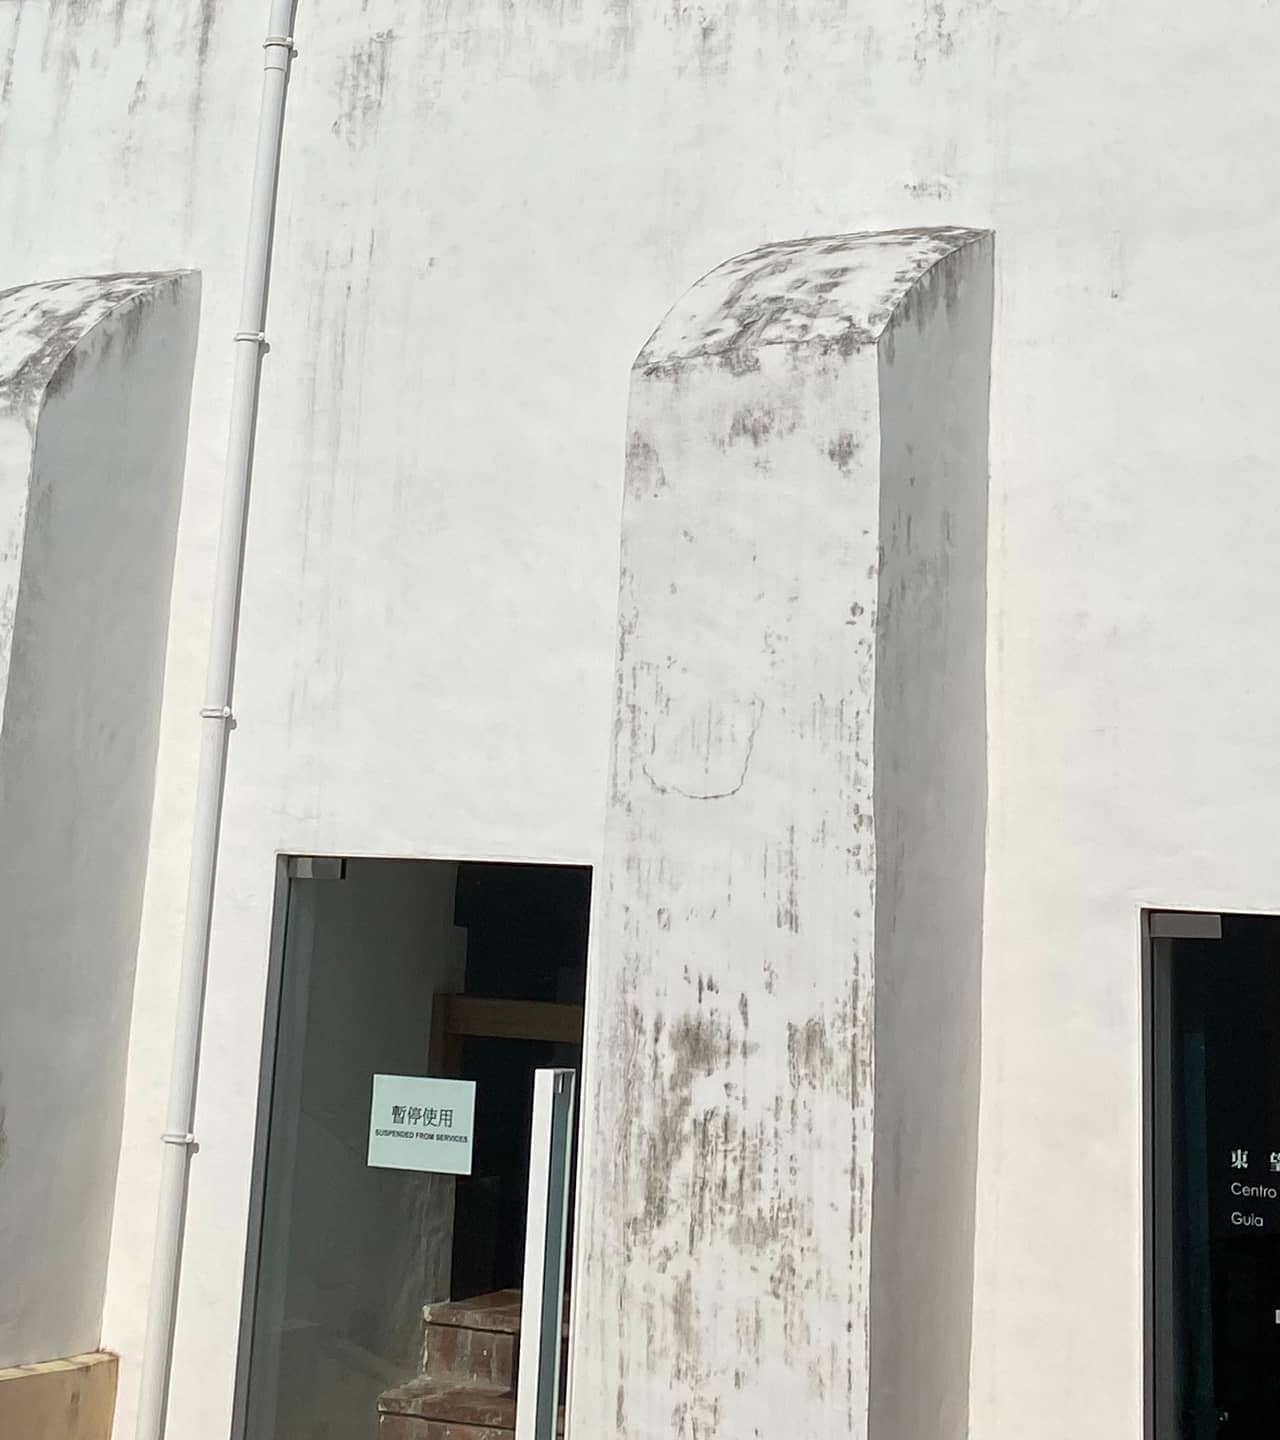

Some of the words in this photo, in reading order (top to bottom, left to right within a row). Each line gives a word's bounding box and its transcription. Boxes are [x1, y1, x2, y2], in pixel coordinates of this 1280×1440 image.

[391, 1105, 454, 1129] 暫停使用
[375, 1128, 414, 1139] SUSPENDED
[415, 1132, 434, 1141] FROM
[435, 1133, 468, 1143] SERVICES
[1230, 1182, 1277, 1199] Centro
[1231, 1211, 1264, 1227] Guia
